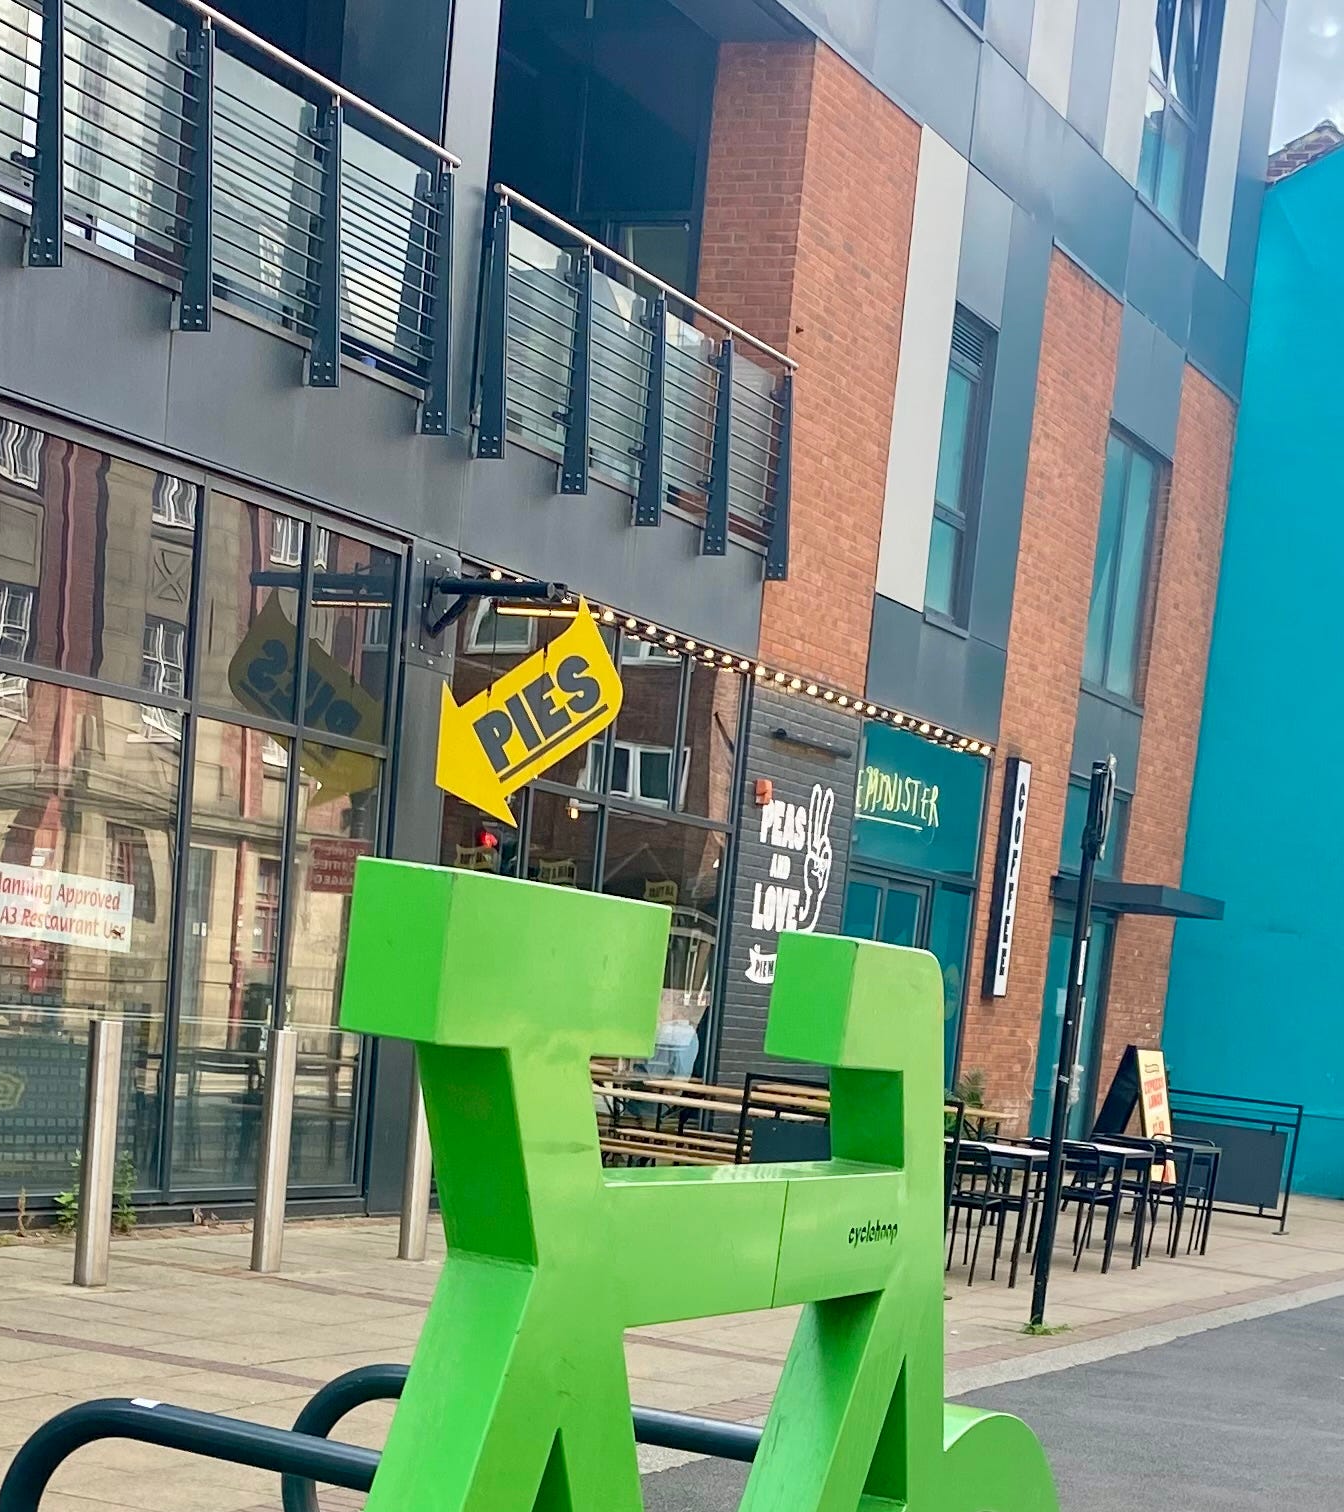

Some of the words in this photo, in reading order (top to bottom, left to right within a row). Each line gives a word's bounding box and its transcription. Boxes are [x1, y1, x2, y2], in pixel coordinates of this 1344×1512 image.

[472, 655, 601, 774] PIES
[856, 766, 939, 827] EMINISTER
[760, 800, 806, 850] PEAS
[770, 853, 791, 879] AND
[999, 783, 1025, 975] COFFEE
[56, 884, 121, 911] Approved
[752, 882, 800, 932] LOVE
[0, 906, 16, 925] A3
[21, 908, 99, 937] Restaurant
[104, 921, 125, 941] Use
[849, 1220, 897, 1248] cyclehoop
